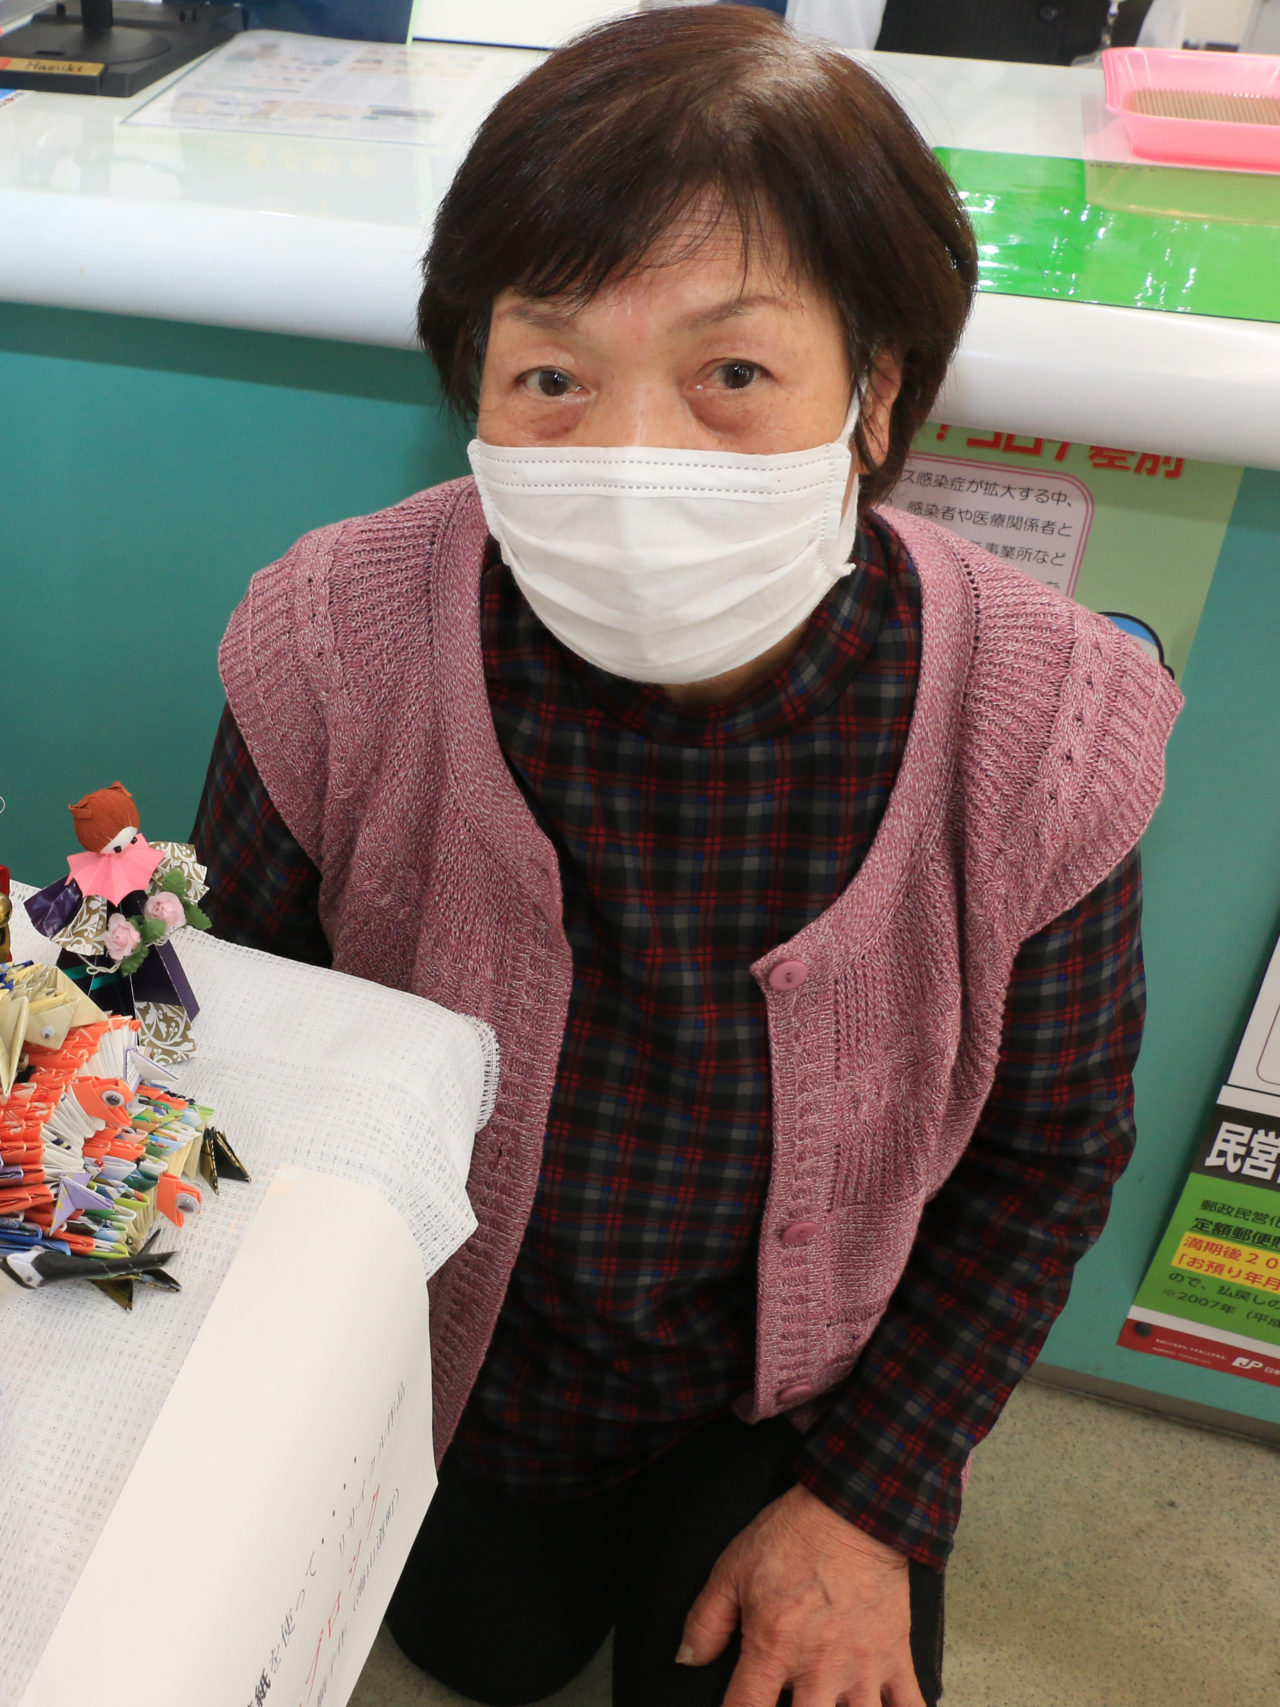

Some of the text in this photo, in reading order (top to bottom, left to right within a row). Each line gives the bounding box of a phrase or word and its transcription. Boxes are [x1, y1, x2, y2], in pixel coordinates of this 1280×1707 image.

[970, 540, 1066, 567] 事業所など
[1204, 1121, 1280, 1183] 民営
[246, 1456, 357, 1707] 紙を使って・・・・
[298, 1483, 381, 1707] ブロック
